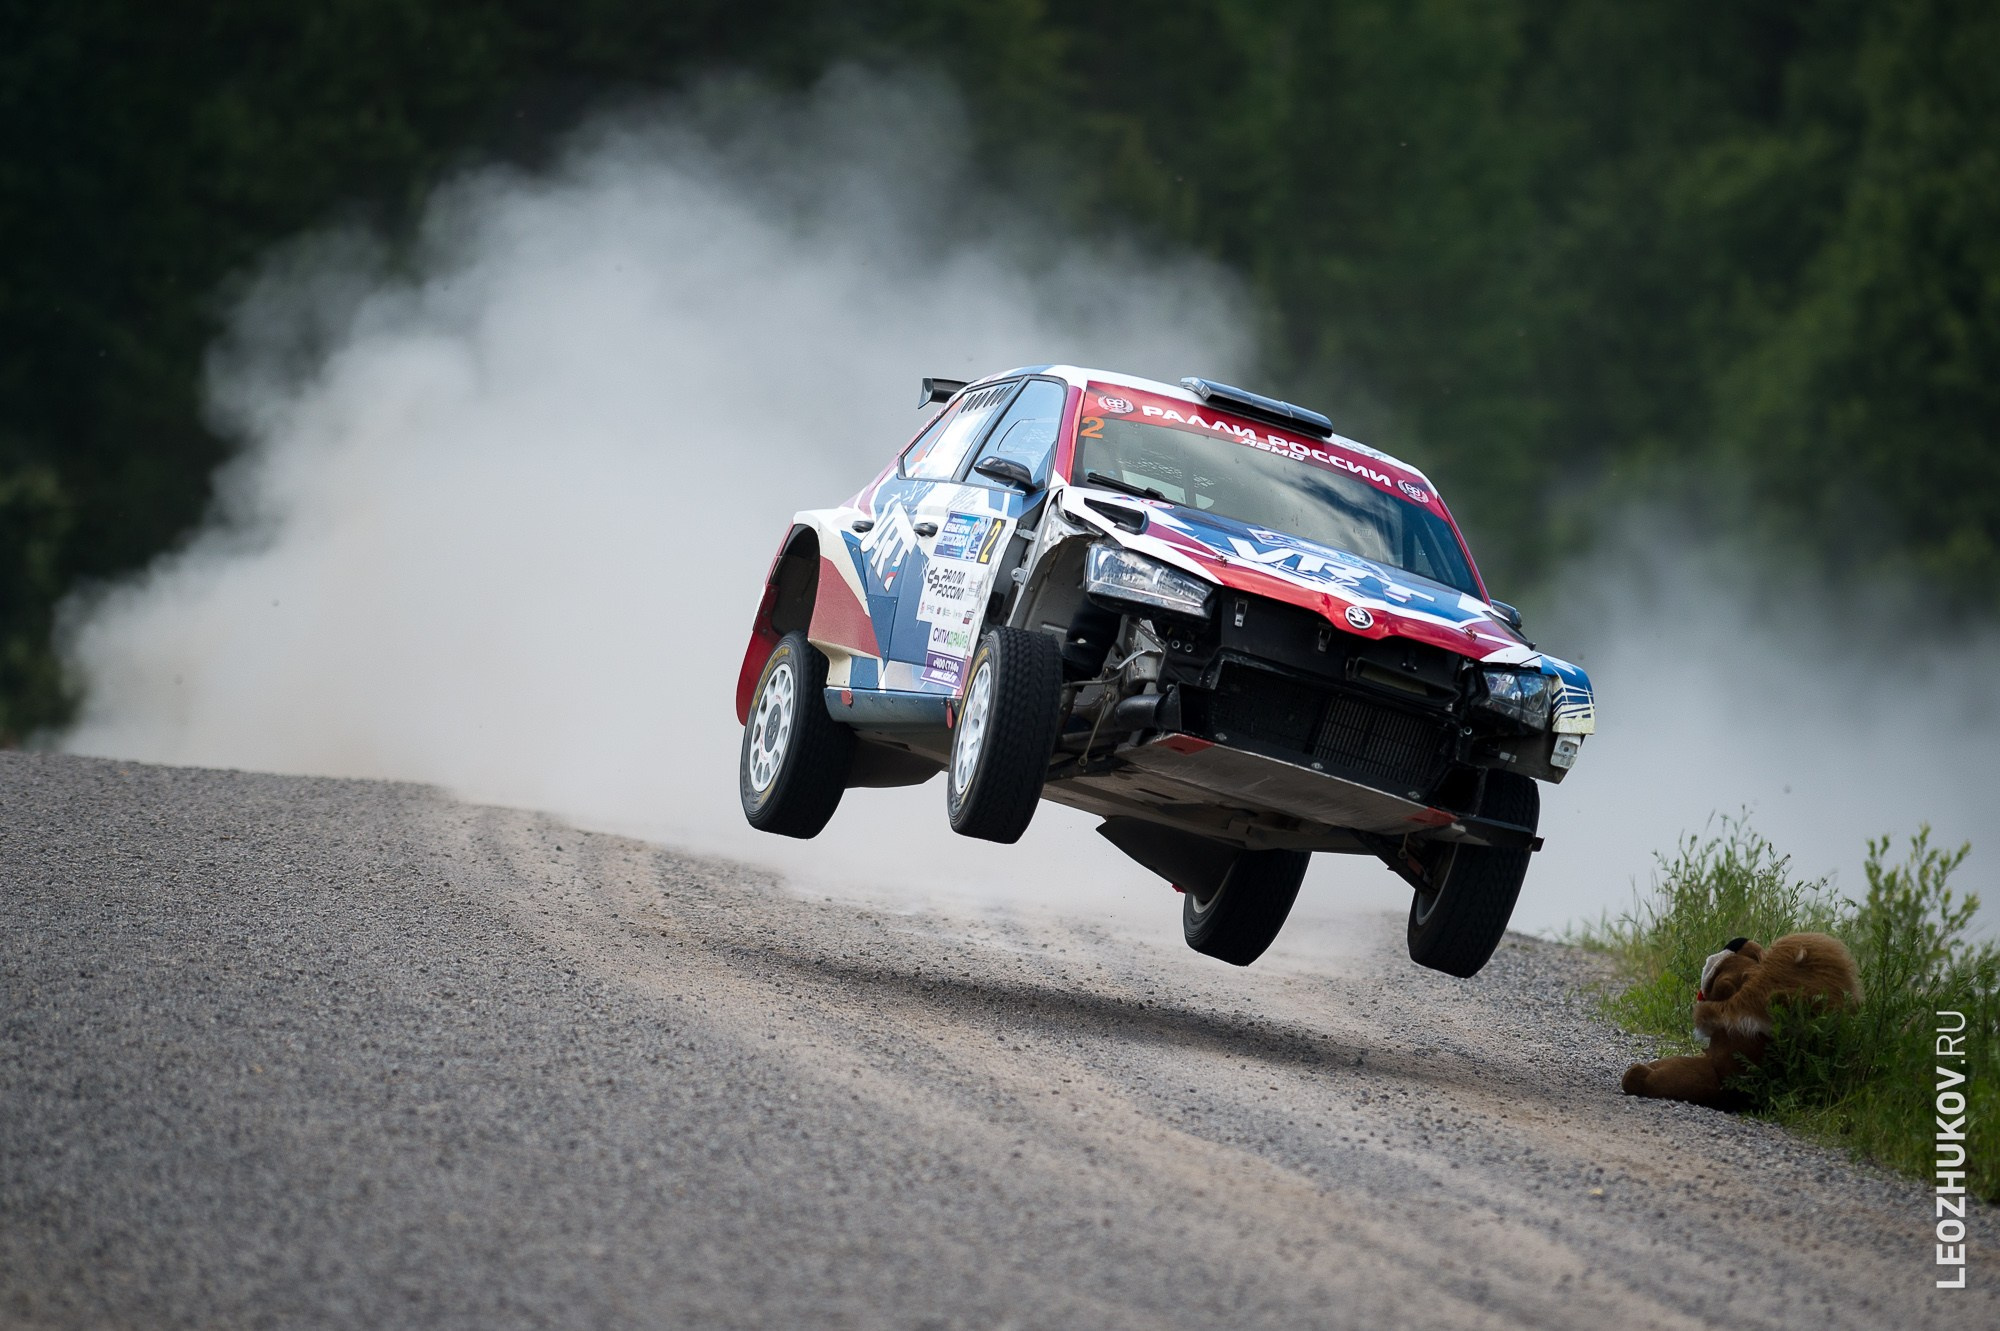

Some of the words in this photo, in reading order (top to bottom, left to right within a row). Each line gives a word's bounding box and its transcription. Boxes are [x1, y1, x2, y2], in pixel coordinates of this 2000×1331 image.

[1080, 416, 1105, 439] 2
[1142, 405, 1257, 440] РАЛЛИ
[1268, 435, 1392, 487] РОССИИ
[979, 519, 1002, 563] 2
[936, 583, 965, 601] РОССИИ
[933, 627, 968, 649] СИТИДРАЙВ
